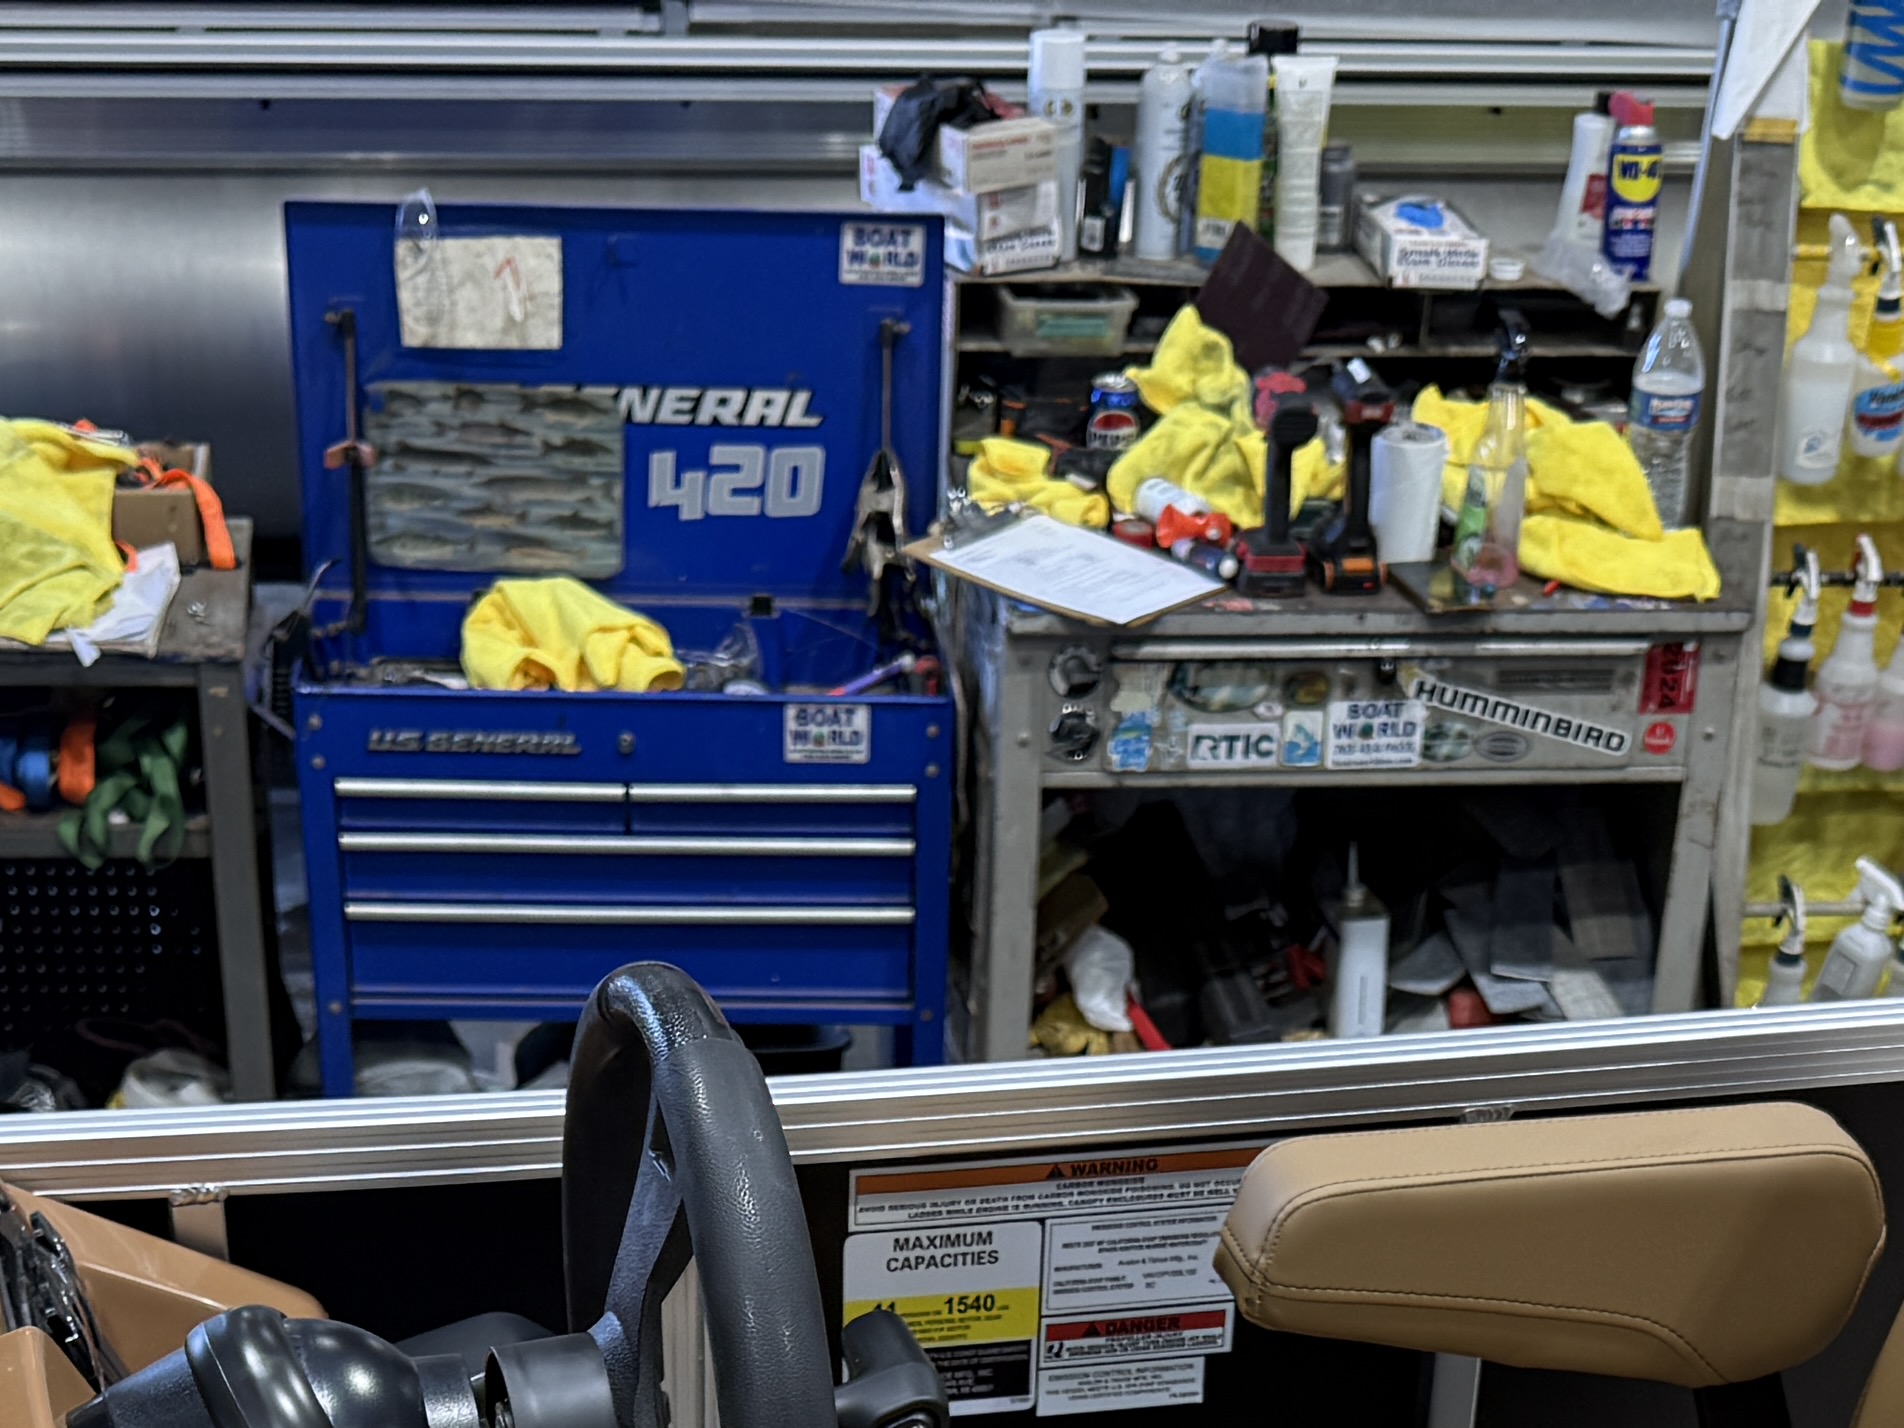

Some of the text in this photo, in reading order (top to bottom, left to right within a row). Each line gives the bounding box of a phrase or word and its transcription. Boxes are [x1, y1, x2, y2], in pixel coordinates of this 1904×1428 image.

[853, 227, 913, 247] BOAT
[539, 385, 824, 426] NERAL
[648, 445, 826, 520] 420
[796, 708, 855, 727] BOAT
[1347, 702, 1405, 719] BOAT
[1415, 679, 1626, 752] HUMMINBIRD
[1191, 735, 1275, 761] RTIC
[1070, 1159, 1159, 1178] WARNING
[893, 1231, 993, 1252] MAXIMUM
[886, 1250, 999, 1272] CAPACITIES
[944, 1294, 995, 1315] 1540
[1105, 1317, 1181, 1335] DANGER
